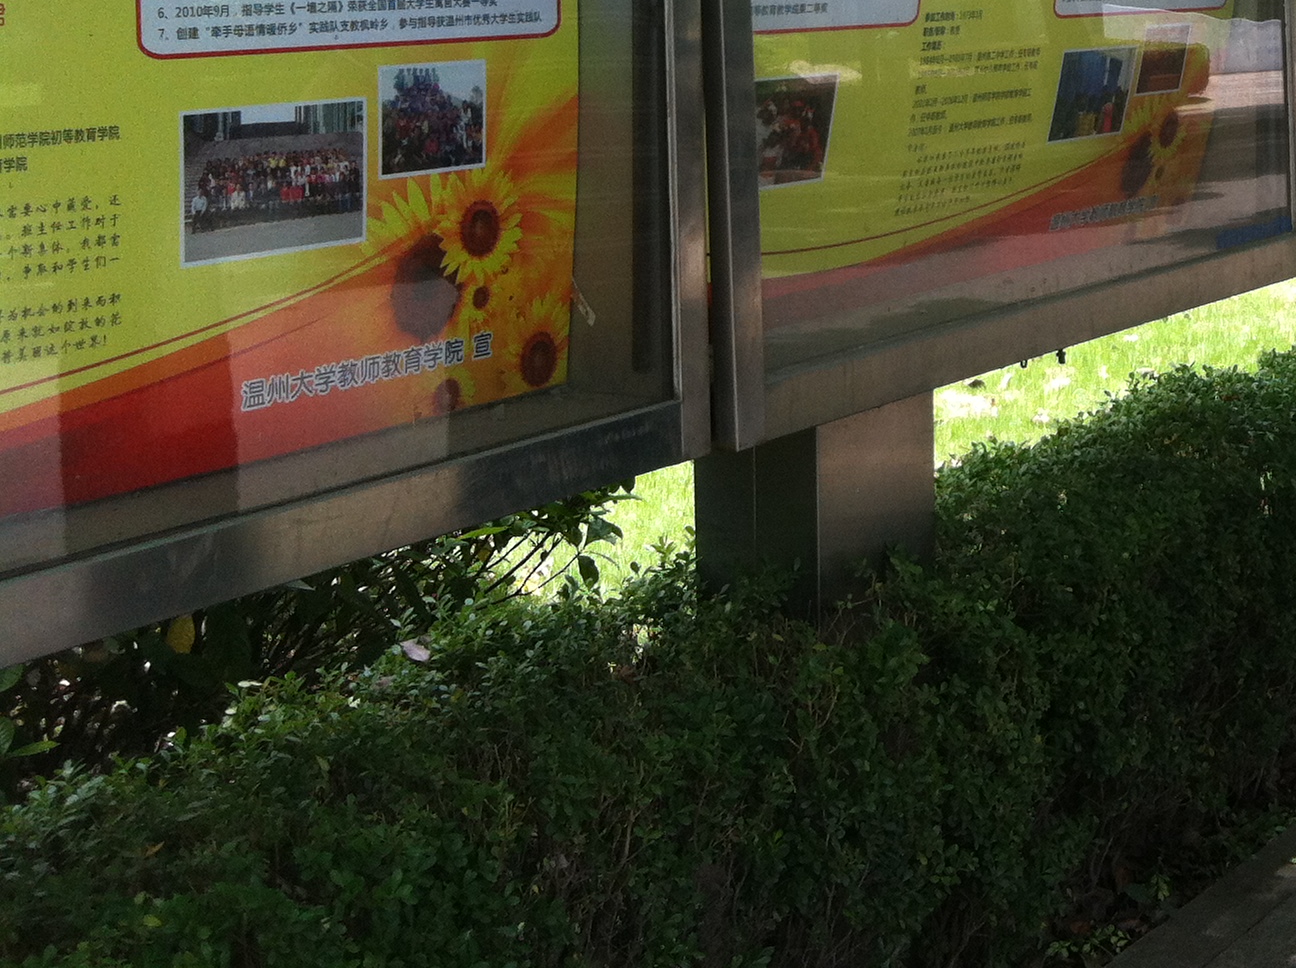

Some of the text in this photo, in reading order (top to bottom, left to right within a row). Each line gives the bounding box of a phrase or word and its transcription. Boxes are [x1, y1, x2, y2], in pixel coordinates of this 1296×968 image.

[0, 125, 121, 150] 师范学院初等教育学院
[0, 156, 28, 174] 学院
[241, 331, 493, 412] 温州大学教师教育学院 宣
